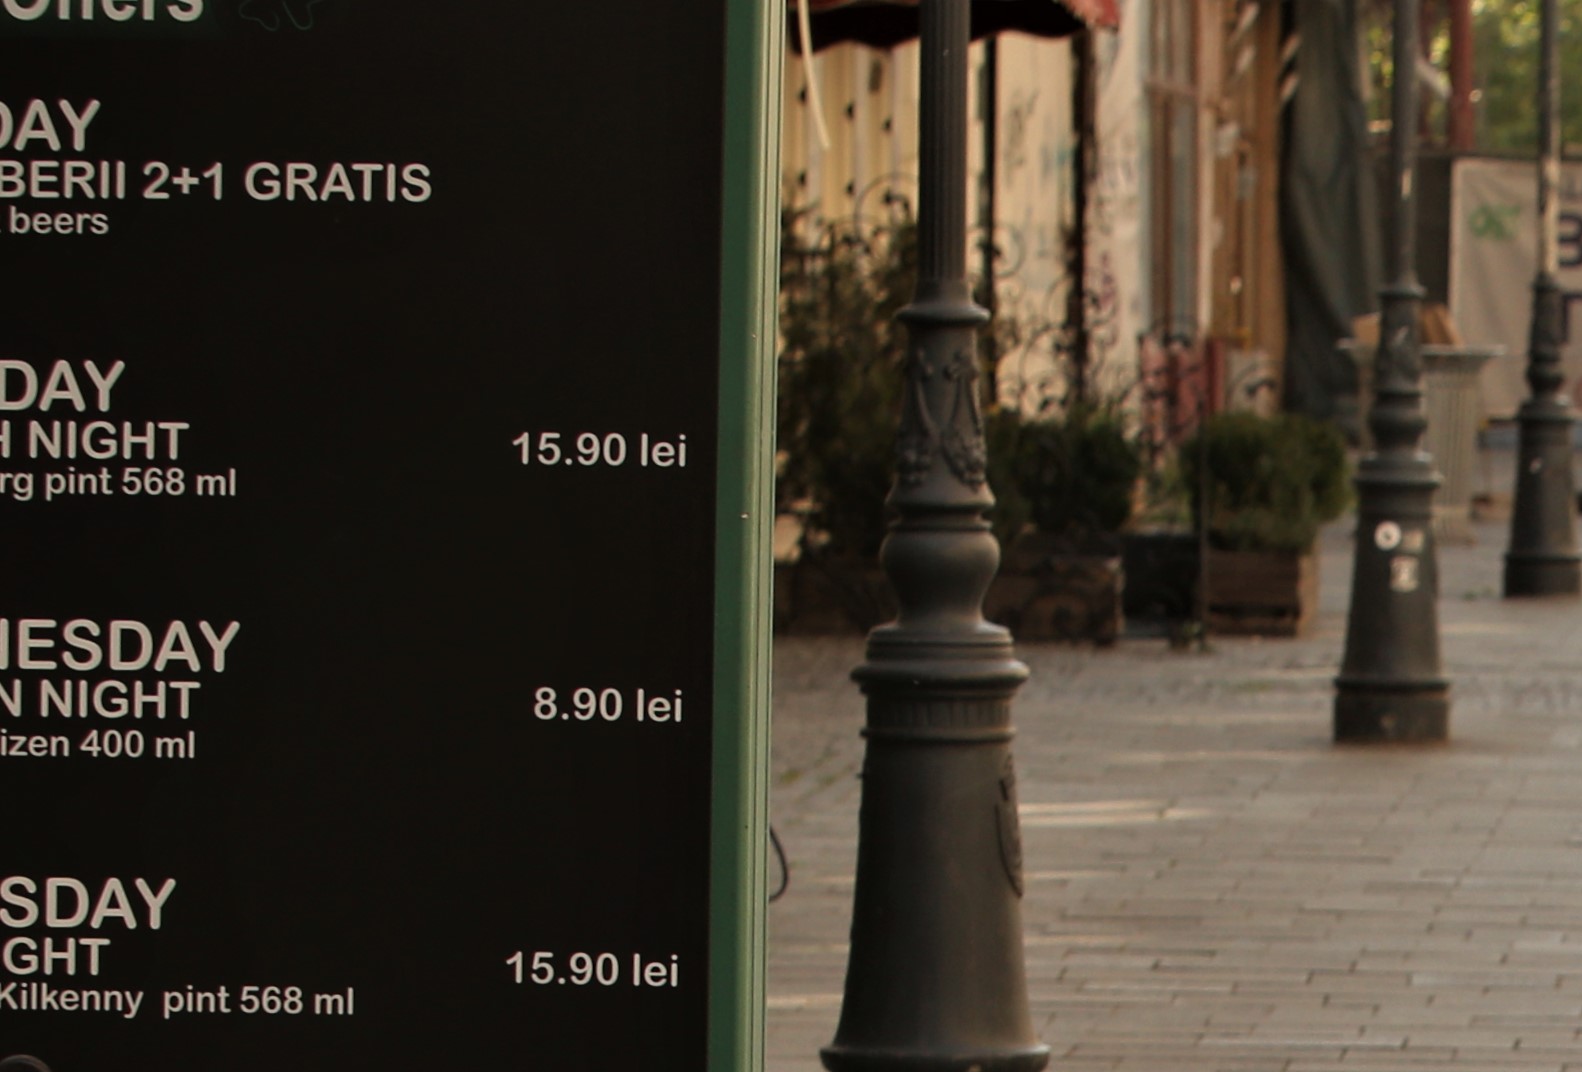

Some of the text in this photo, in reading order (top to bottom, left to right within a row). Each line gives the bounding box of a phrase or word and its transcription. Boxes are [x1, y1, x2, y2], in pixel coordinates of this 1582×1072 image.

[0, 99, 101, 152] AY
[142, 161, 224, 200] 2+1
[244, 161, 432, 203] GRATIS
[9, 205, 110, 235] beers
[0, 359, 126, 413] DAY
[28, 420, 190, 461] NIGHT
[512, 431, 688, 468] 15.90 lei
[45, 466, 114, 503] pint
[121, 467, 187, 497] 568
[196, 467, 237, 497] ml
[0, 617, 241, 673] ESDAY
[40, 678, 203, 720] NIGHT
[533, 686, 683, 723] 8.90 lei
[79, 729, 145, 759] 400
[155, 730, 196, 760] ml
[0, 875, 177, 931] SDAY
[2, 936, 111, 977] GHT
[505, 950, 680, 988] 15.90 lei
[0, 981, 355, 1021] Kilkenny pint 568 ml
